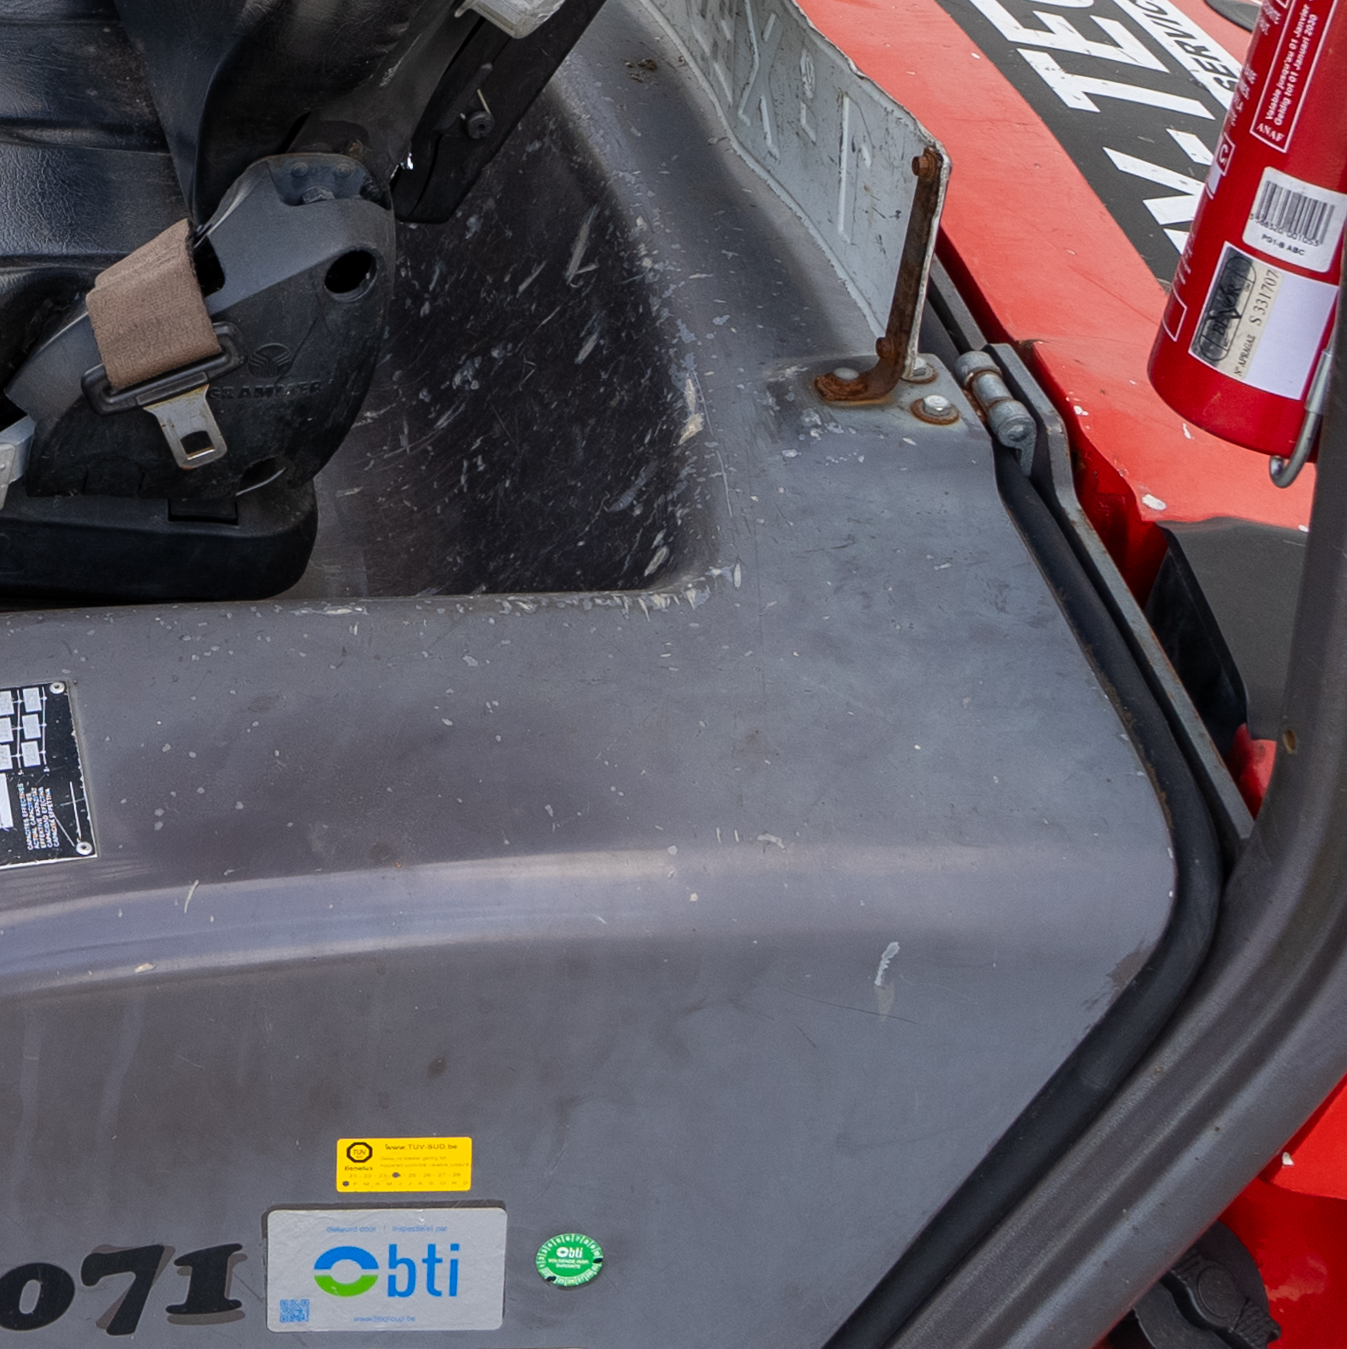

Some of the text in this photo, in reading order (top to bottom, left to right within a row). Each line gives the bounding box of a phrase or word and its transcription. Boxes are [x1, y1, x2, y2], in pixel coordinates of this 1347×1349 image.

[1303, 12, 1320, 38] 2030
[1257, 122, 1285, 143] ANAF
[387, 1243, 460, 1298] bti
